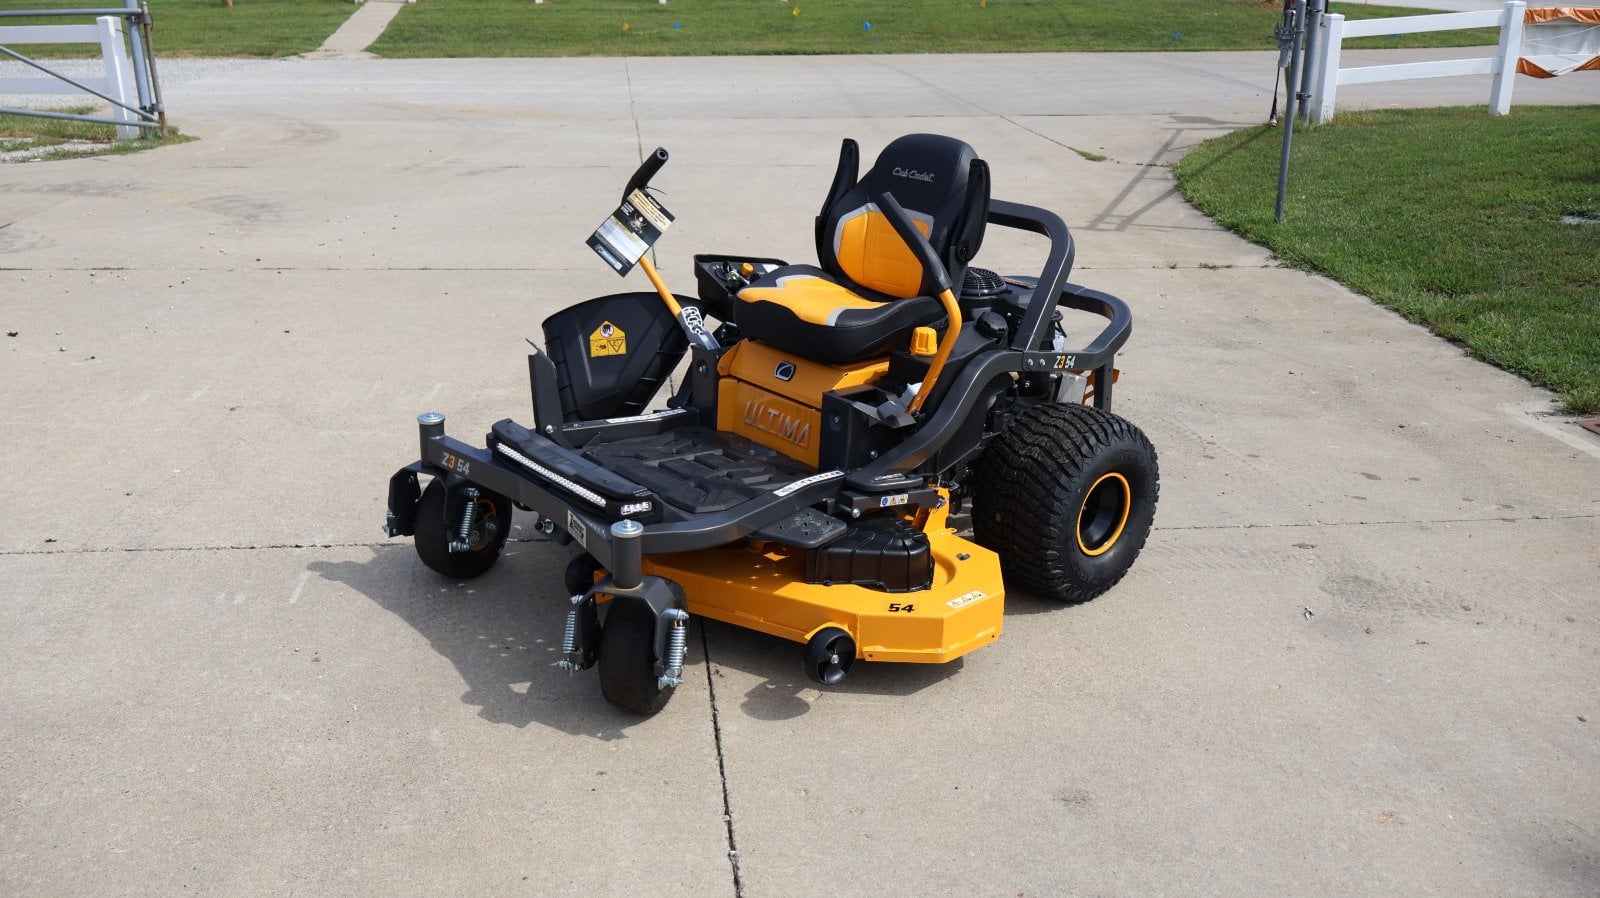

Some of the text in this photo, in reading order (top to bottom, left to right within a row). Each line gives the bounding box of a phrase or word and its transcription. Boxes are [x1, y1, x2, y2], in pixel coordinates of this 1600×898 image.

[893, 167, 935, 182] Cub Cadet
[1053, 355, 1076, 369] Z3 54
[743, 399, 810, 448] ULTIMA
[441, 452, 470, 475] Z3 54
[888, 603, 915, 613] 54
